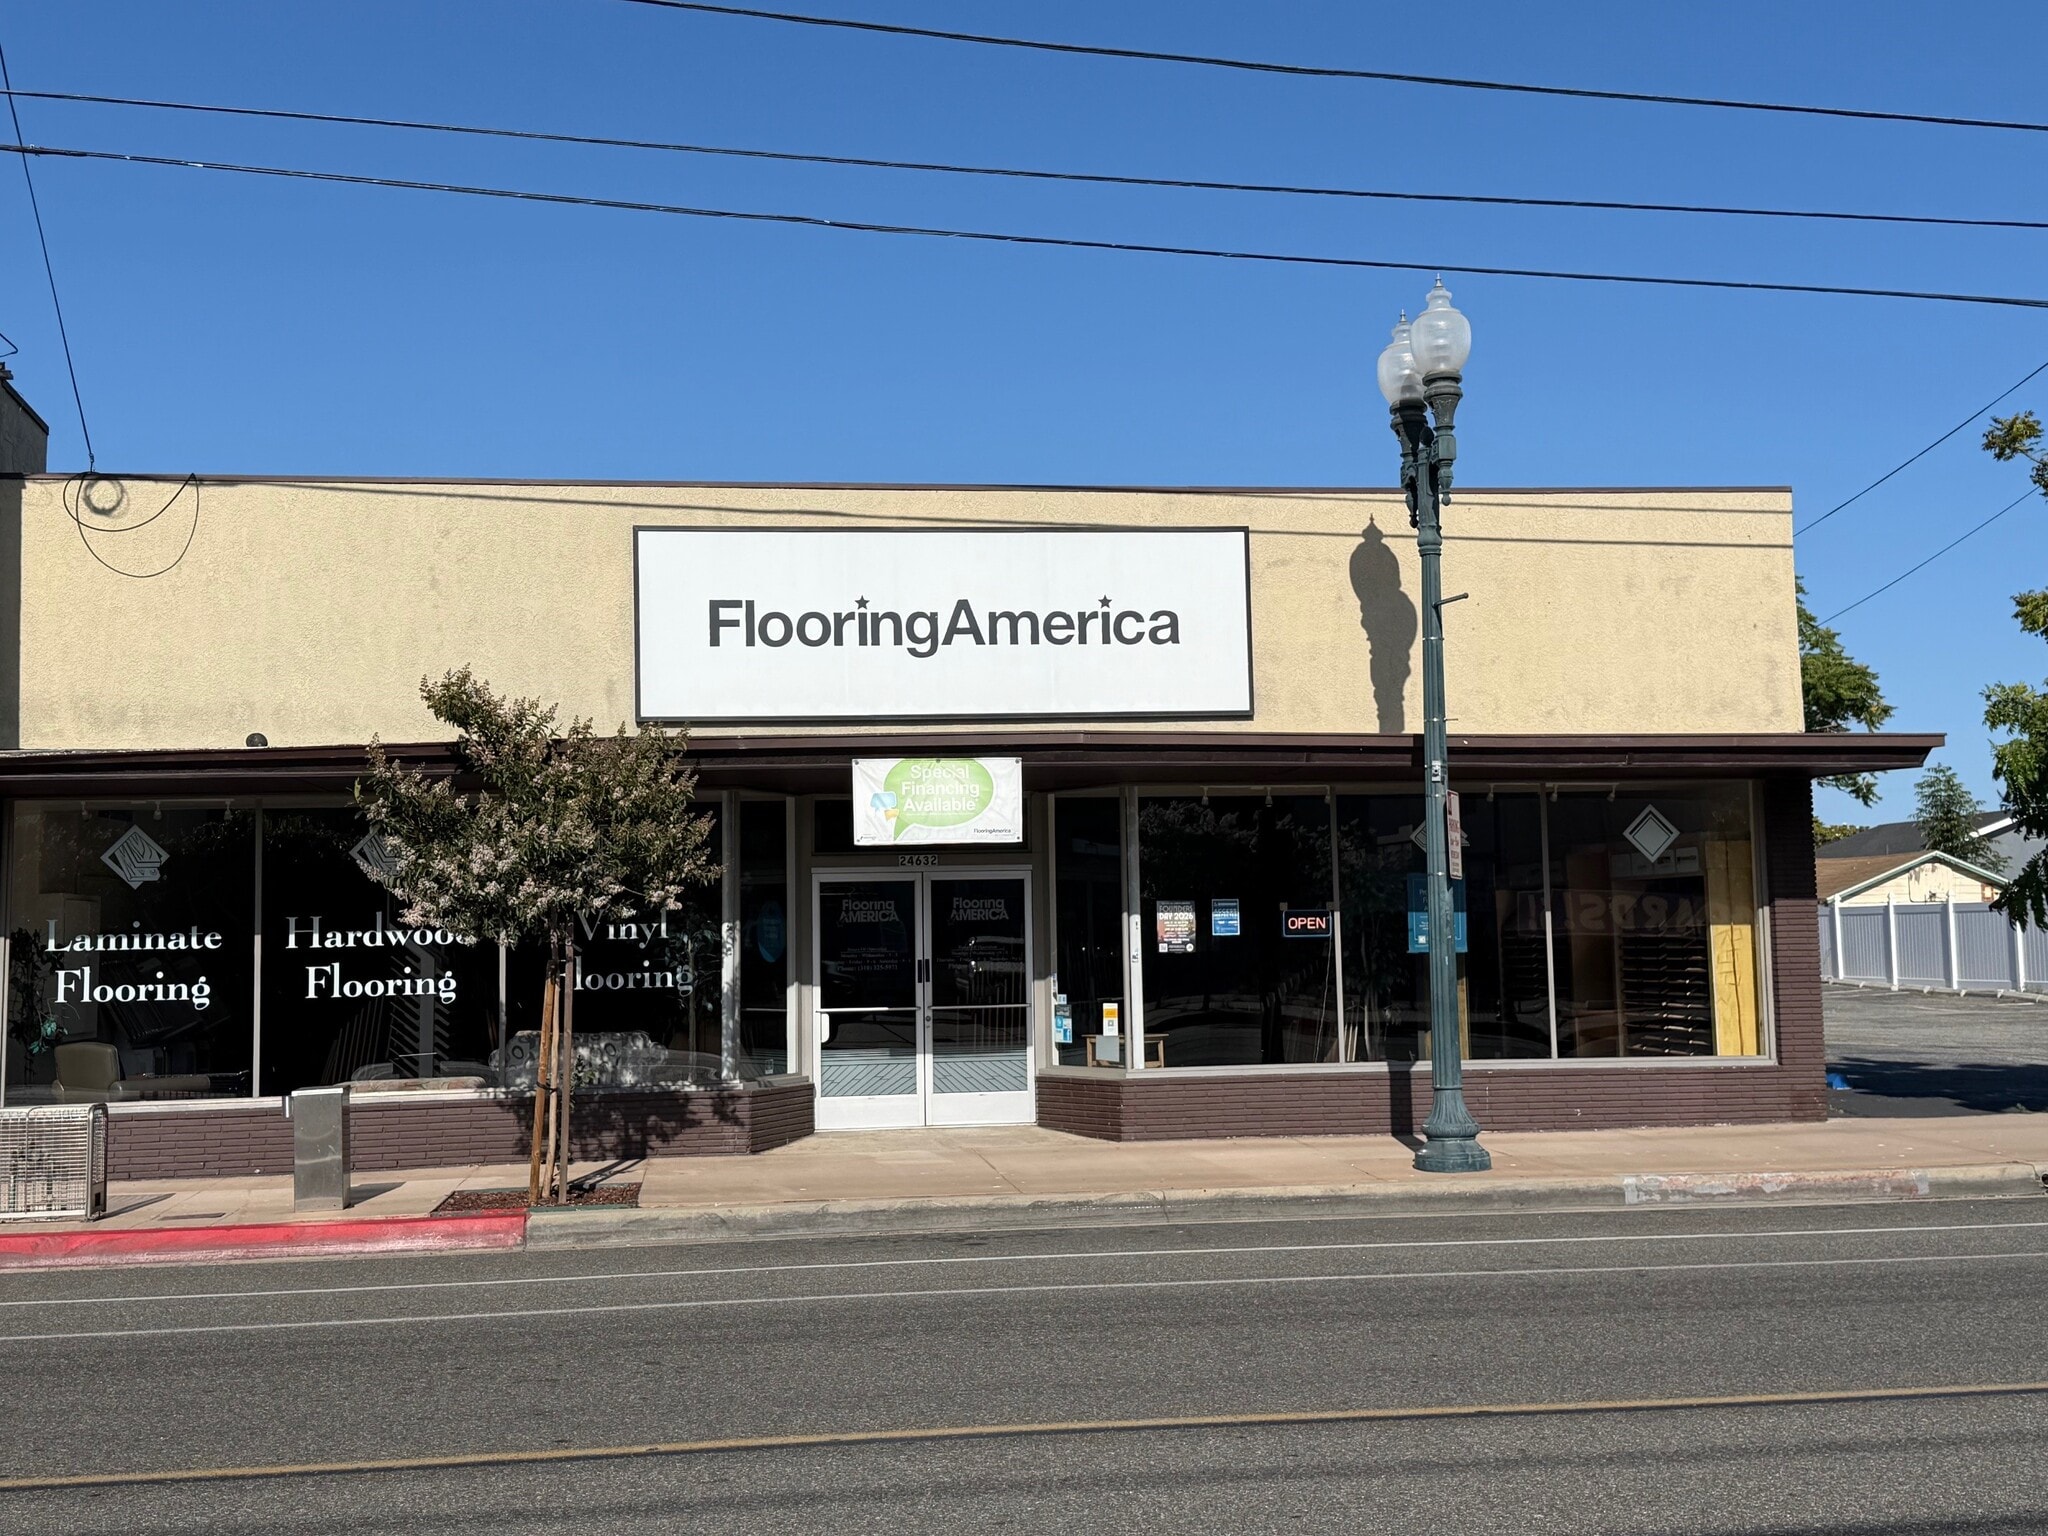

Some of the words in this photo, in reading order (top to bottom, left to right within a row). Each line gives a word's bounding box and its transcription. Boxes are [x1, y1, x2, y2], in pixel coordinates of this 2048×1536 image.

[708, 595, 1181, 658] FlooringAmerica
[911, 764, 970, 782] Special
[901, 781, 980, 798] Financing
[900, 855, 938, 866] 24632
[842, 899, 895, 911] Flooring
[953, 897, 1005, 910] Flooring
[839, 910, 900, 923] AMERICA
[950, 908, 1009, 921] AMERICA
[1288, 917, 1326, 929] OPEN
[45, 919, 222, 952] Laminate
[285, 911, 466, 949] Hardwoo
[575, 908, 669, 949] Vinyl
[305, 962, 457, 1004] Flooring
[558, 956, 694, 998] looring
[54, 966, 211, 1011] Flooring
